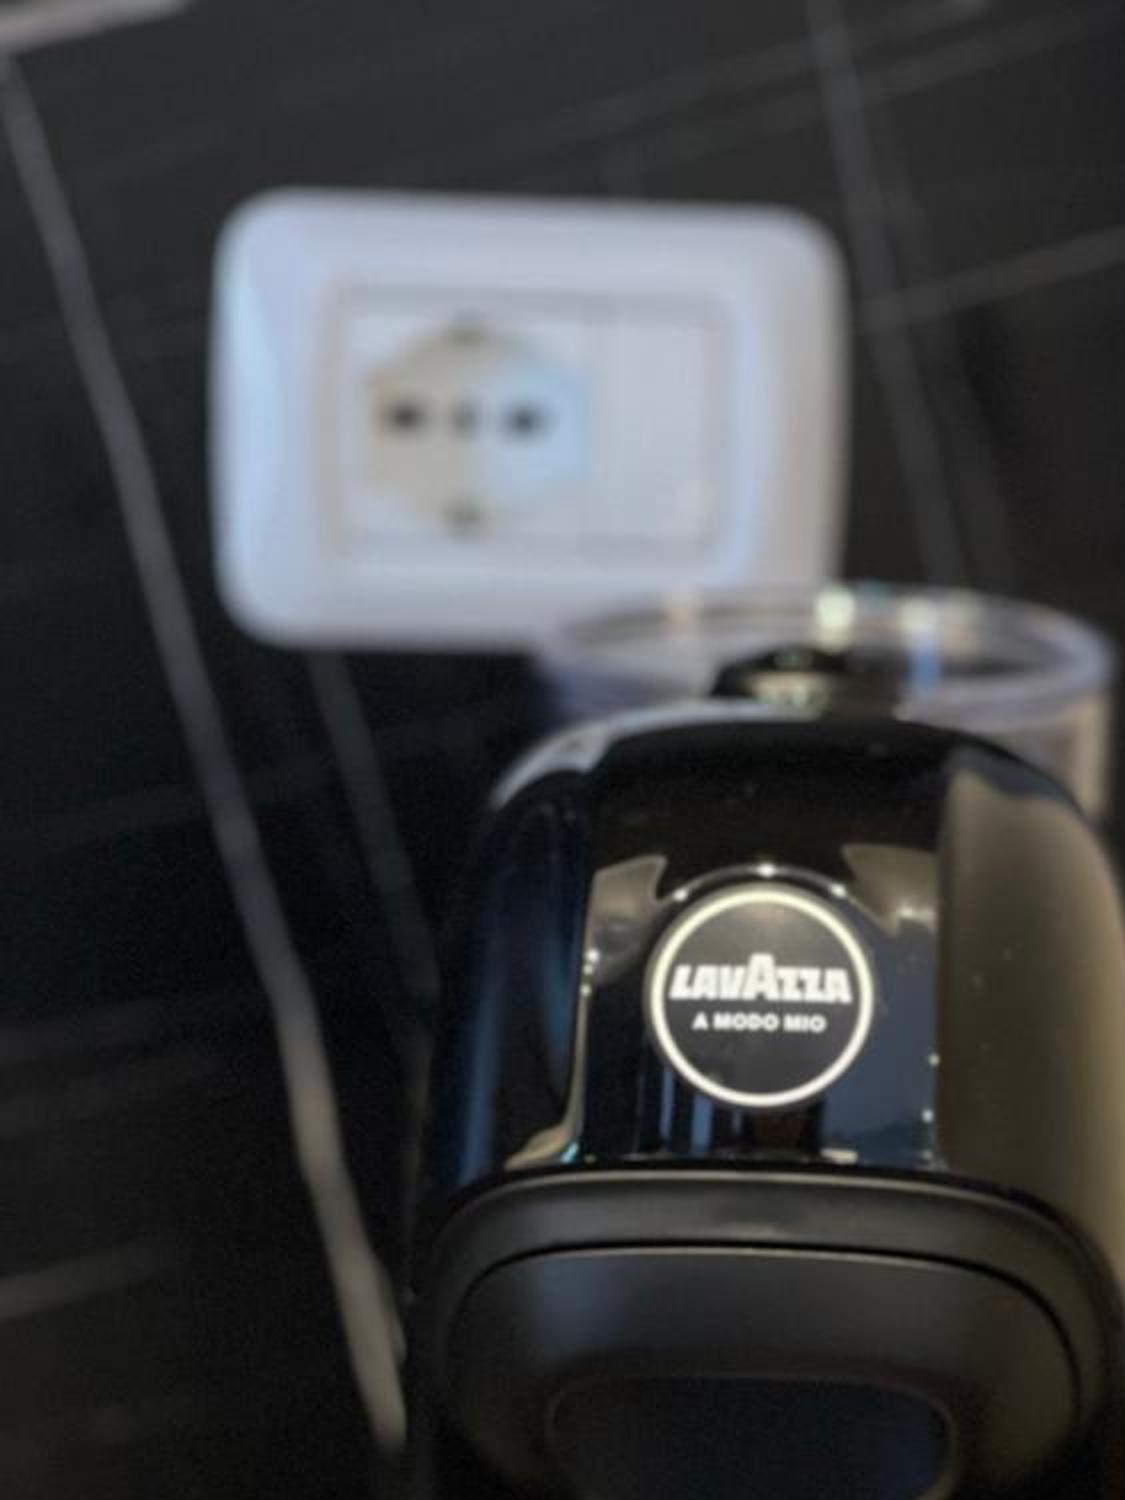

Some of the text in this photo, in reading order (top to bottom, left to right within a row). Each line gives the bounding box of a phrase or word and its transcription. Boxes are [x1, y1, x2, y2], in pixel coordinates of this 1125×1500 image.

[668, 953, 852, 1004] LAVAZZA
[692, 1012, 827, 1033] A MODO MIO
